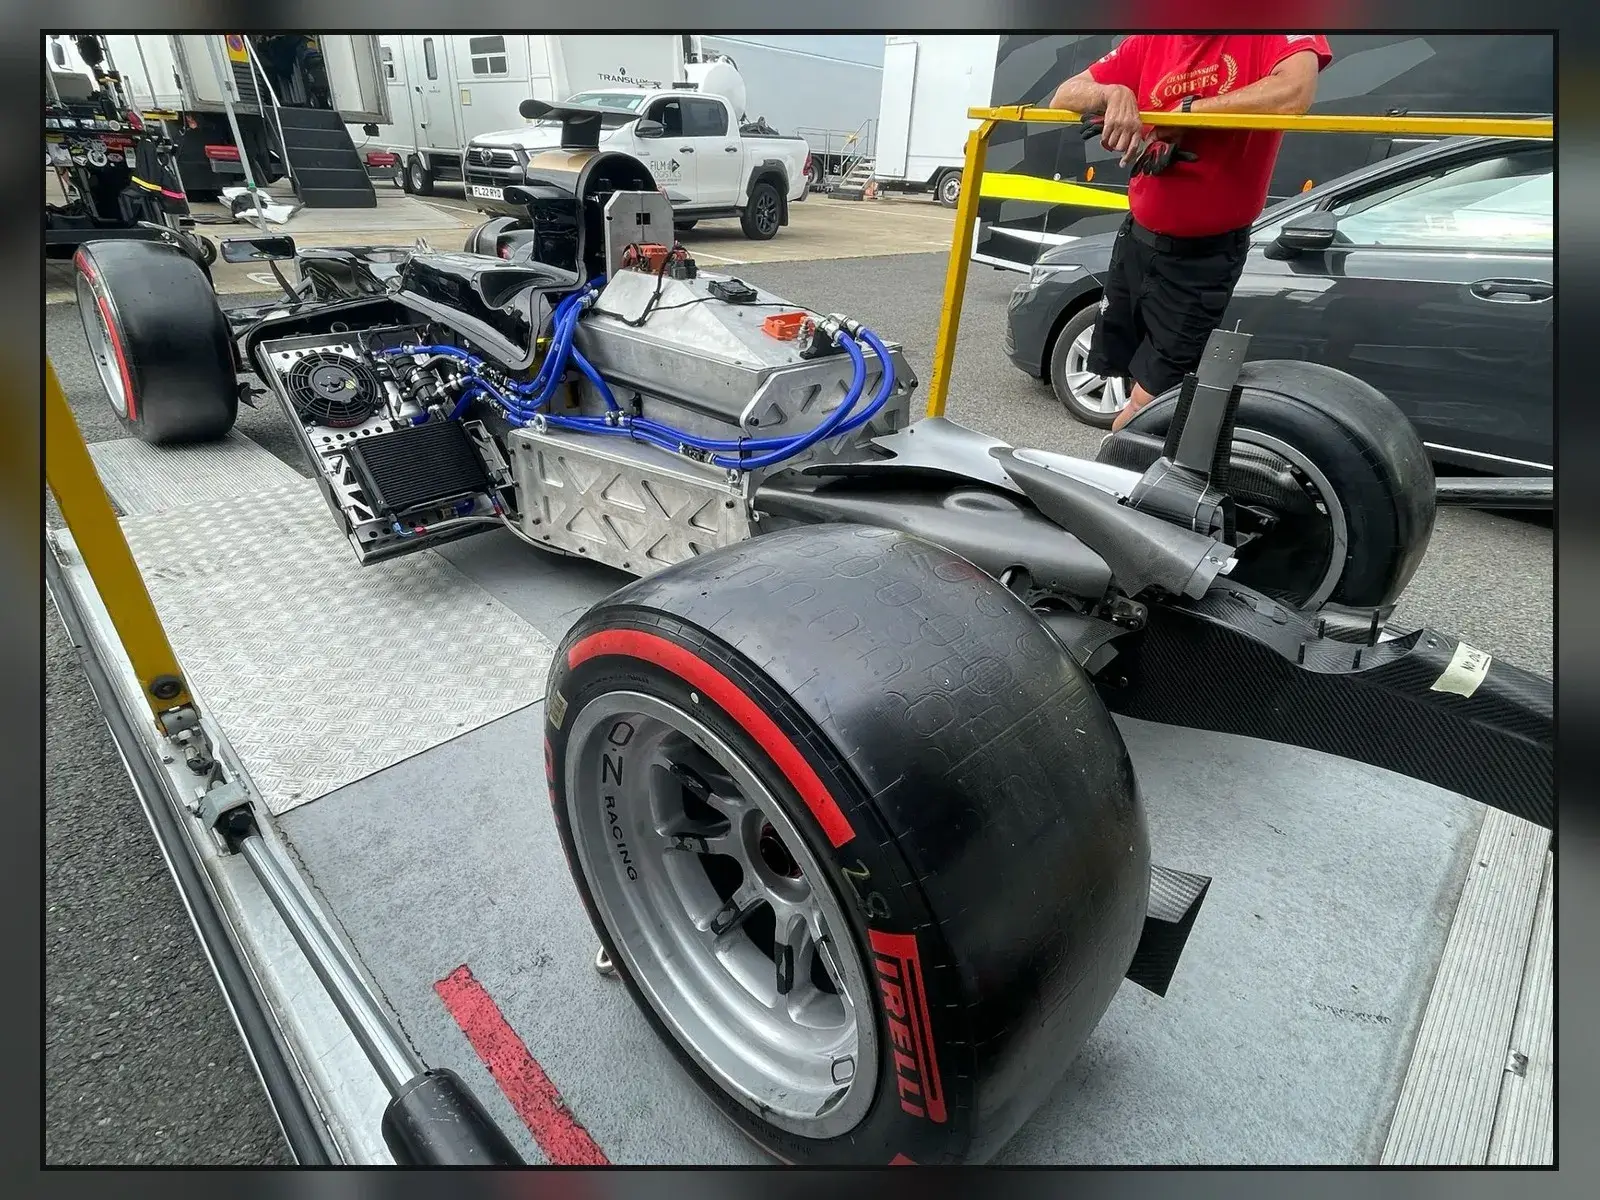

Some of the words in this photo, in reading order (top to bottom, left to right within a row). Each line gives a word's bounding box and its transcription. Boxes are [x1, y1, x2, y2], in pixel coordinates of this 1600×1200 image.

[1164, 73, 1219, 97] COFFEES
[650, 160, 667, 171] FILM
[653, 171, 682, 179] OGISTICS
[474, 186, 490, 197] FL22
[604, 795, 638, 881] RACING
[868, 928, 948, 1124] PIRELLI
